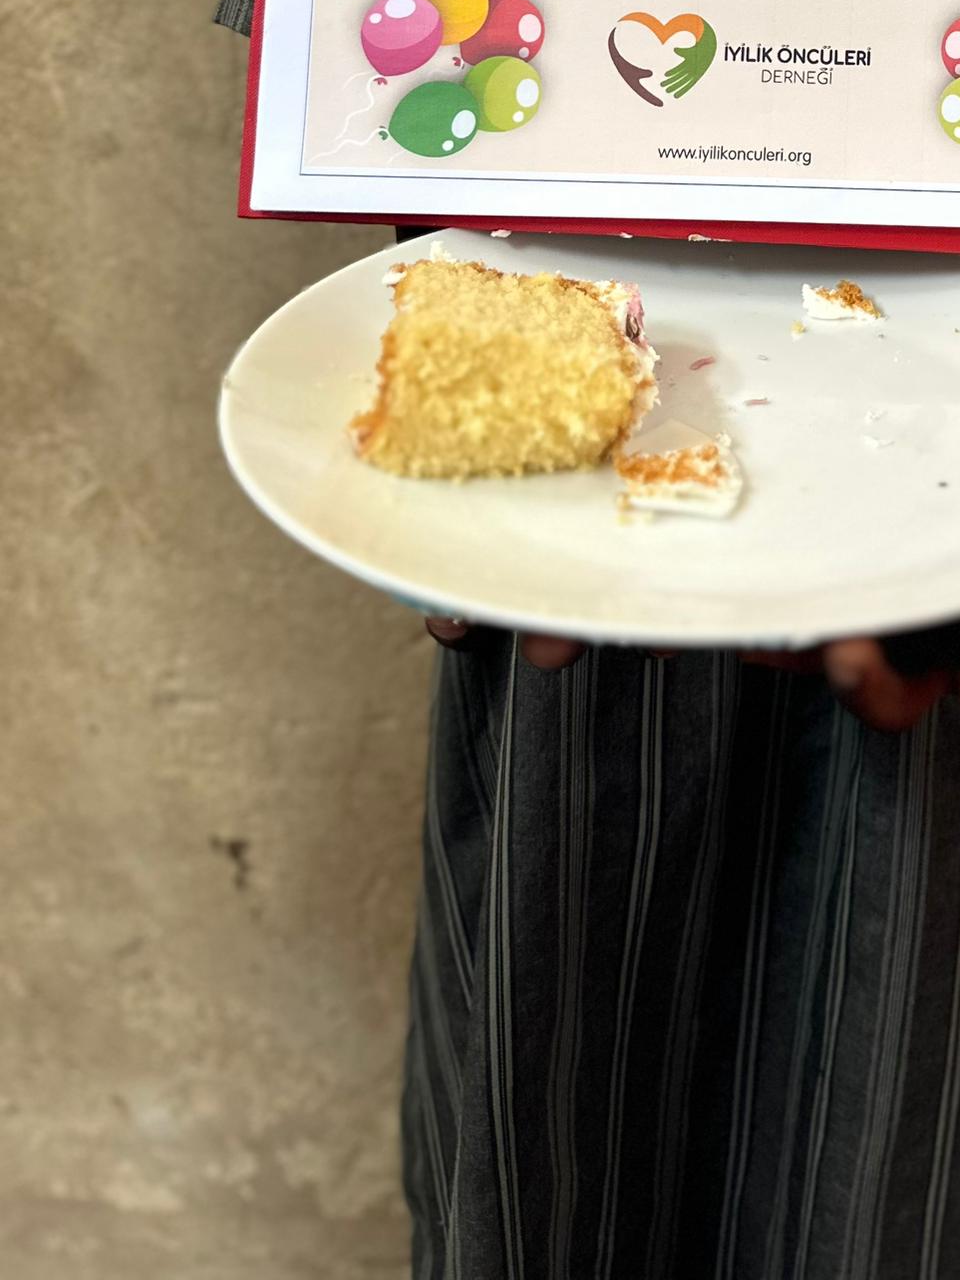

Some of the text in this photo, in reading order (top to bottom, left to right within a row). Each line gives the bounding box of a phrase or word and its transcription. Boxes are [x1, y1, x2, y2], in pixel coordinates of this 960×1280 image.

[724, 42, 872, 66] İYİLİK ÖNCÜLERİ
[761, 67, 834, 85] DERNEĞİ
[658, 145, 812, 166] www.iyilikonculeri.org
